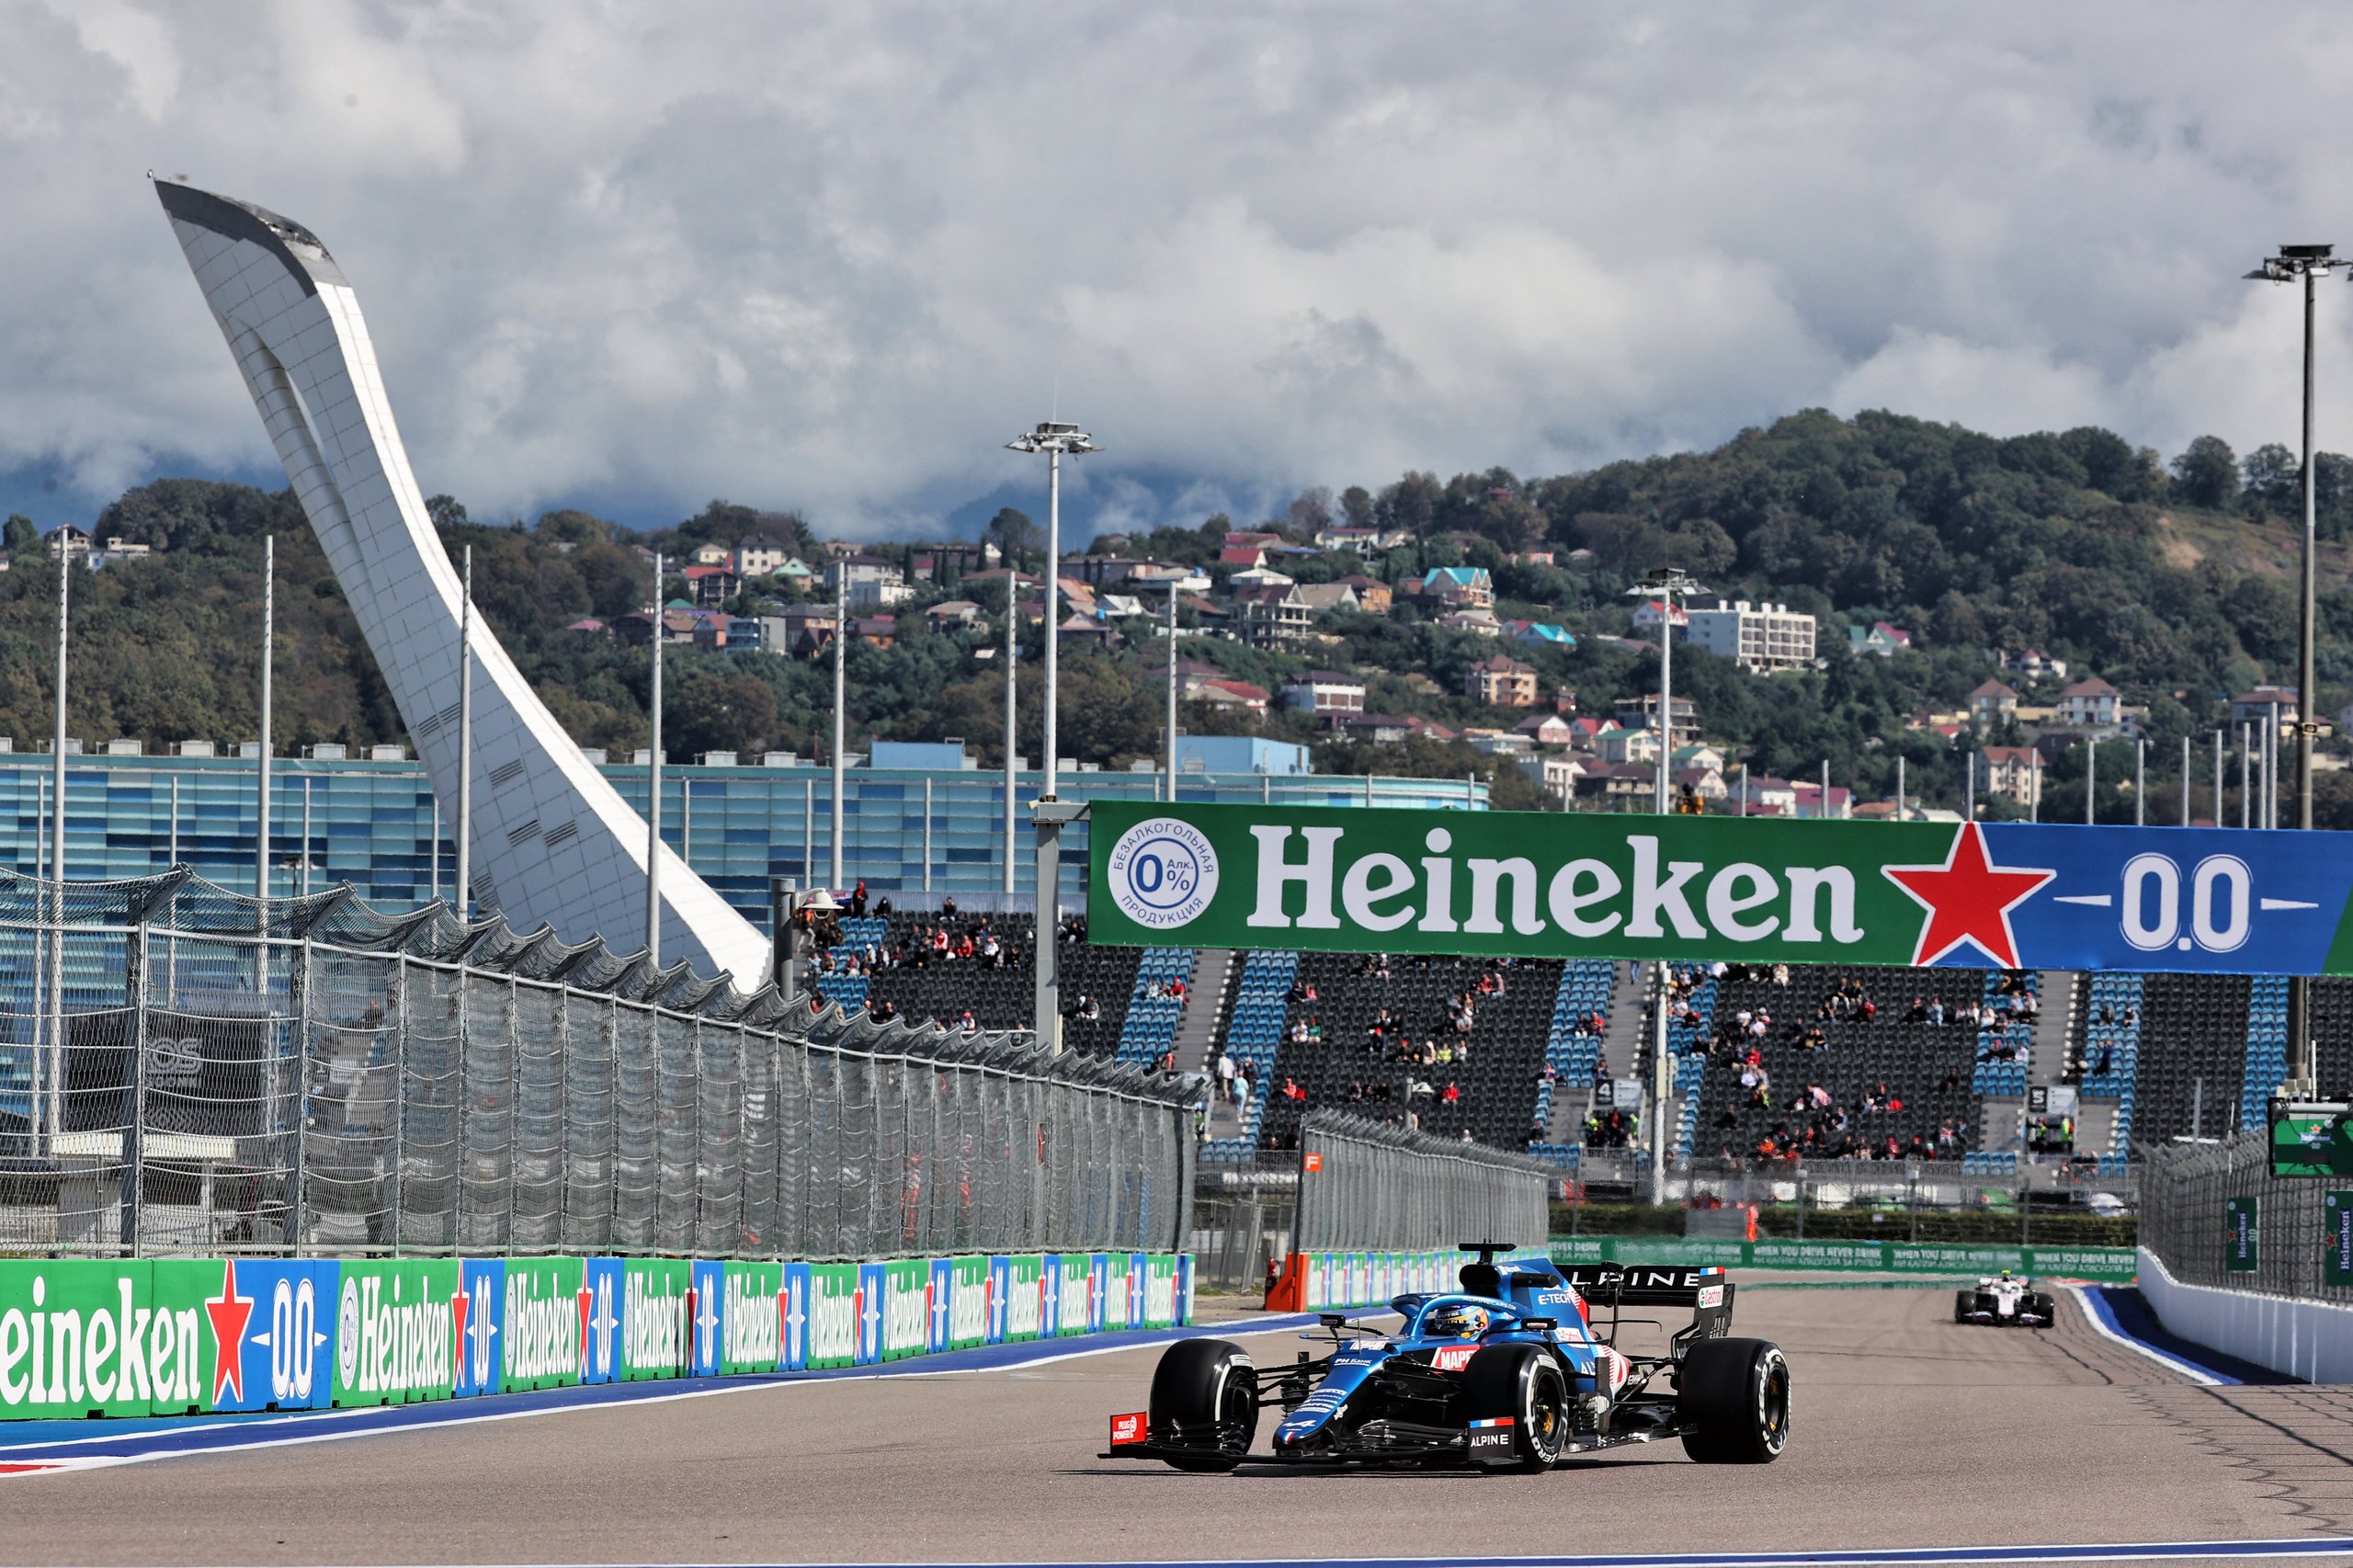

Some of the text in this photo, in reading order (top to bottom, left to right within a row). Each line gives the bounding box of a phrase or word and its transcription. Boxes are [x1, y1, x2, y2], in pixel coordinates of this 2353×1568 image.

[1114, 824, 1213, 873] БЕЗАЛКОГОЛЬНАЯ
[1136, 854, 1163, 892] 0
[1166, 859, 1194, 869] Алк.
[1246, 824, 1865, 944] Heineken
[1121, 895, 1204, 925] ПРОДУКЦИЯ
[2120, 853, 2253, 953] 0.0
[1598, 1083, 1611, 1096] 4
[1306, 1156, 1319, 1168] F
[1780, 1245, 1799, 1256] YOU
[2340, 1210, 2350, 1270] Heineken
[1921, 1250, 1939, 1260] YOU
[2061, 1253, 2079, 1263] YOU
[1571, 1271, 1699, 1286] LPINE
[1538, 1292, 1571, 1305] E-TECH
[515, 1270, 576, 1379] Heineken
[632, 1270, 685, 1369] Heineken
[732, 1272, 777, 1363] Heineken
[0, 1276, 315, 1403] eineken 0.0
[358, 1274, 449, 1392] Heineken
[1441, 1350, 1475, 1369] MAPF
[1471, 1435, 1509, 1448] ALPINE
[1530, 1437, 1558, 1463] ZERO
